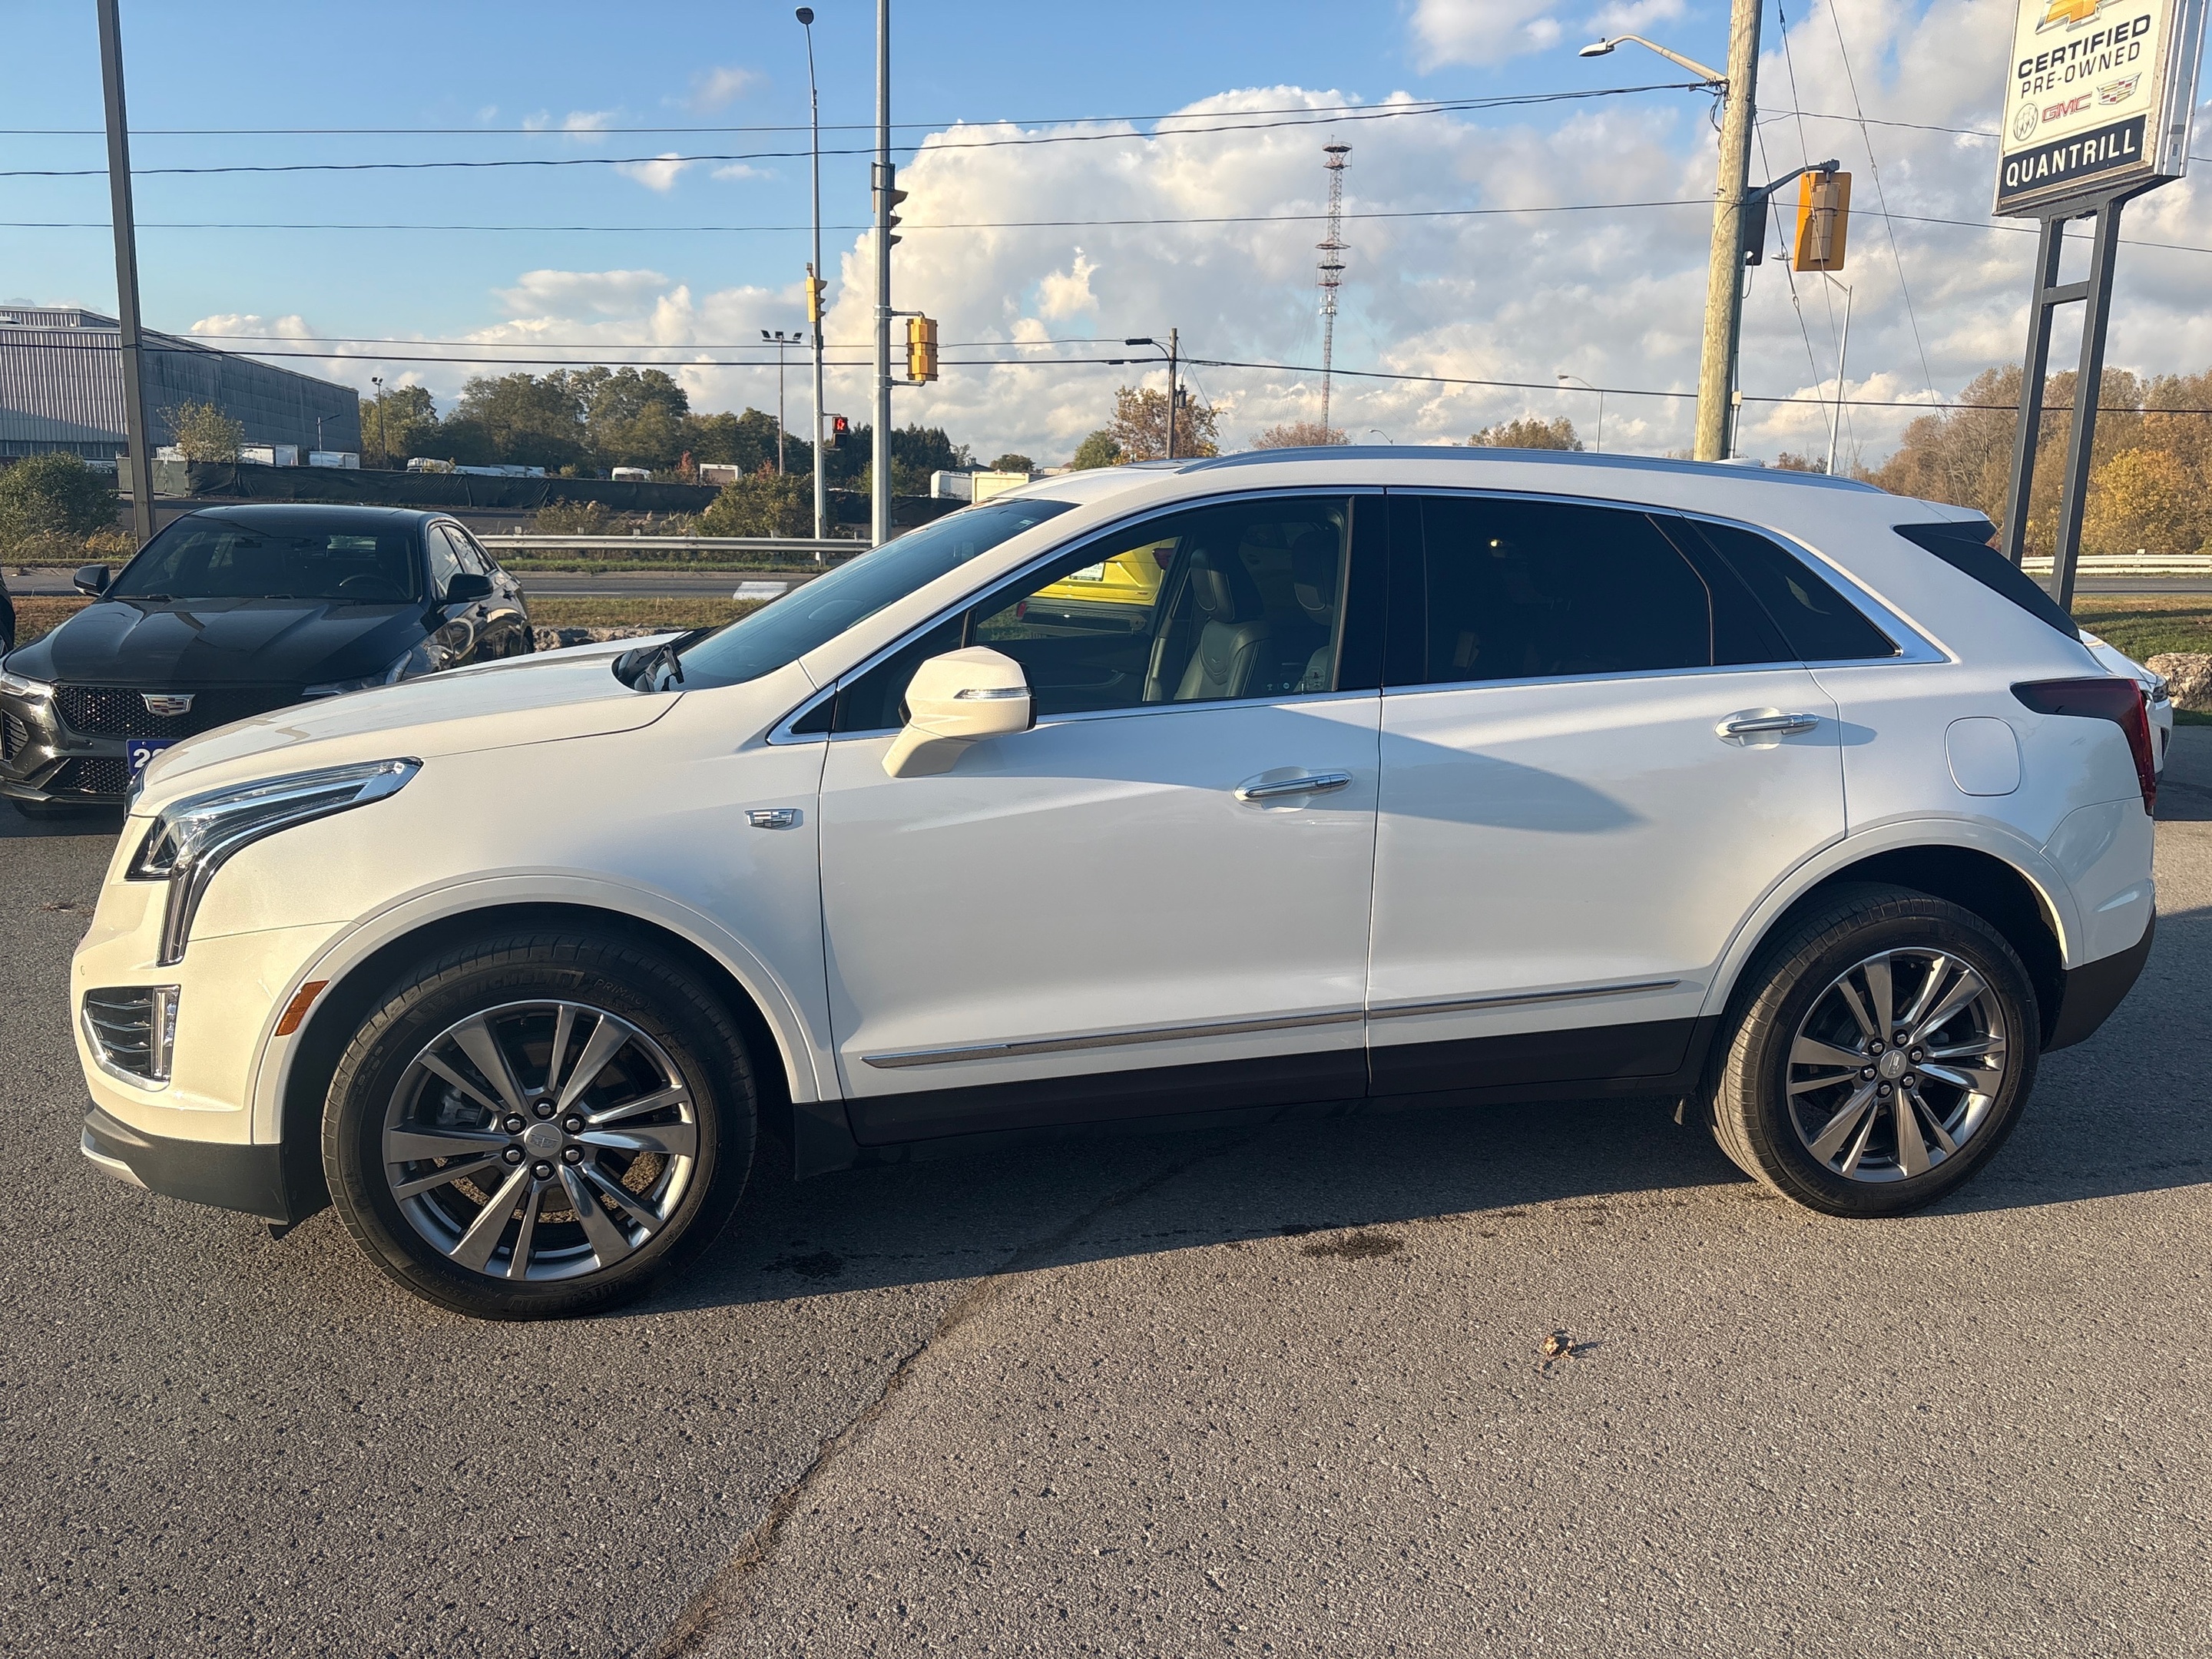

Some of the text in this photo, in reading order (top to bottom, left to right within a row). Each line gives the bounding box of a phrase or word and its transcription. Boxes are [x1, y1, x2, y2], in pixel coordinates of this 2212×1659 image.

[2018, 14, 2151, 79] CERTIFIED
[2021, 41, 2141, 99] PRE-OWNED
[2041, 91, 2093, 124] GMC
[2005, 128, 2136, 187] QUANTRILL
[459, 972, 652, 1009] MICHELIN PRIMACY
